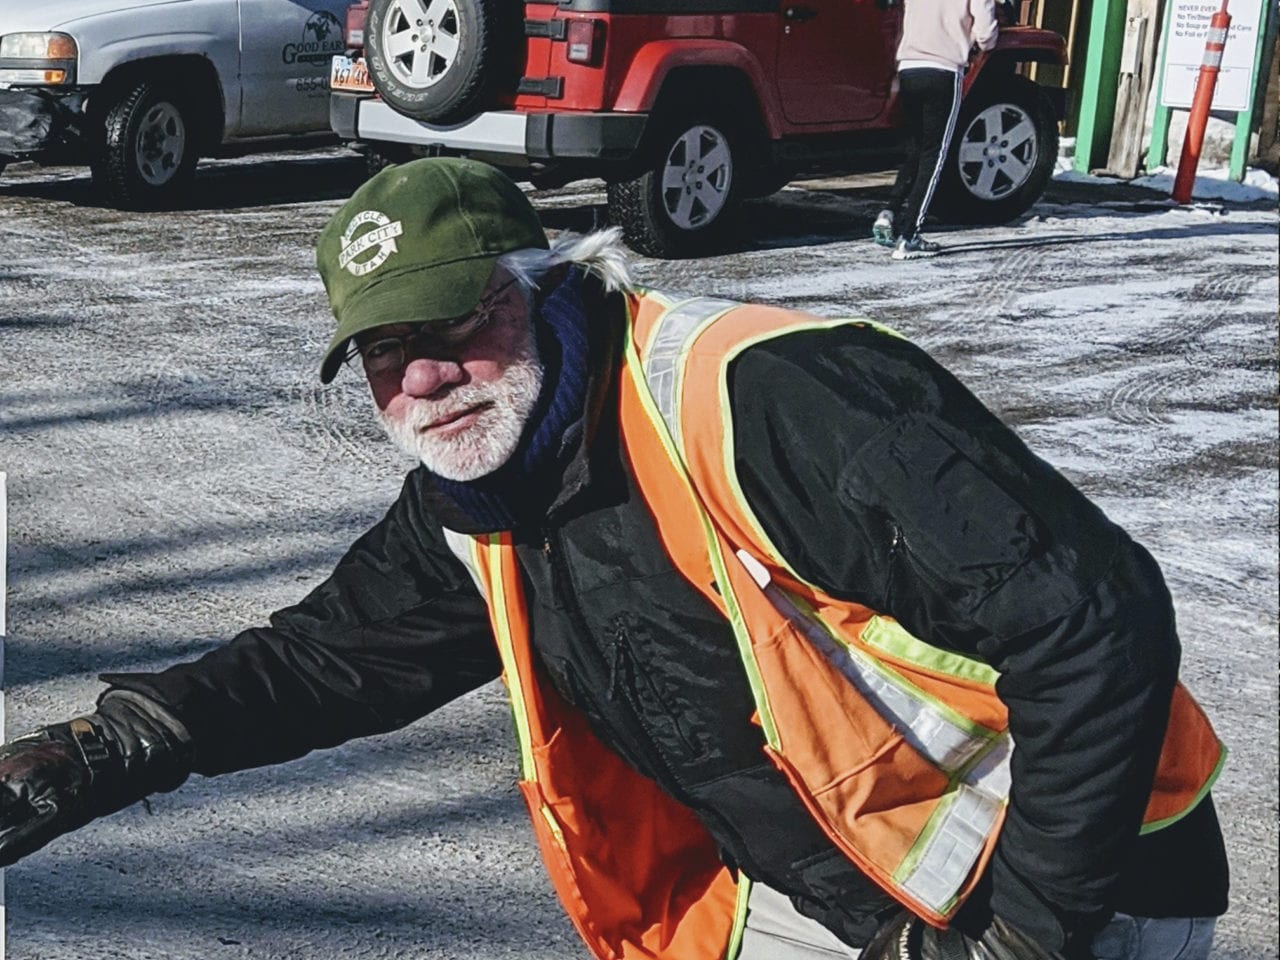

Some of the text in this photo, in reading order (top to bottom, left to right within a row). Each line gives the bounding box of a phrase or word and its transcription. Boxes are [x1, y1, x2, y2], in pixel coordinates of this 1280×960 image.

[322, 40, 345, 52] EAR
[341, 222, 399, 265] PARK CITY
[355, 252, 387, 275] UTAH
